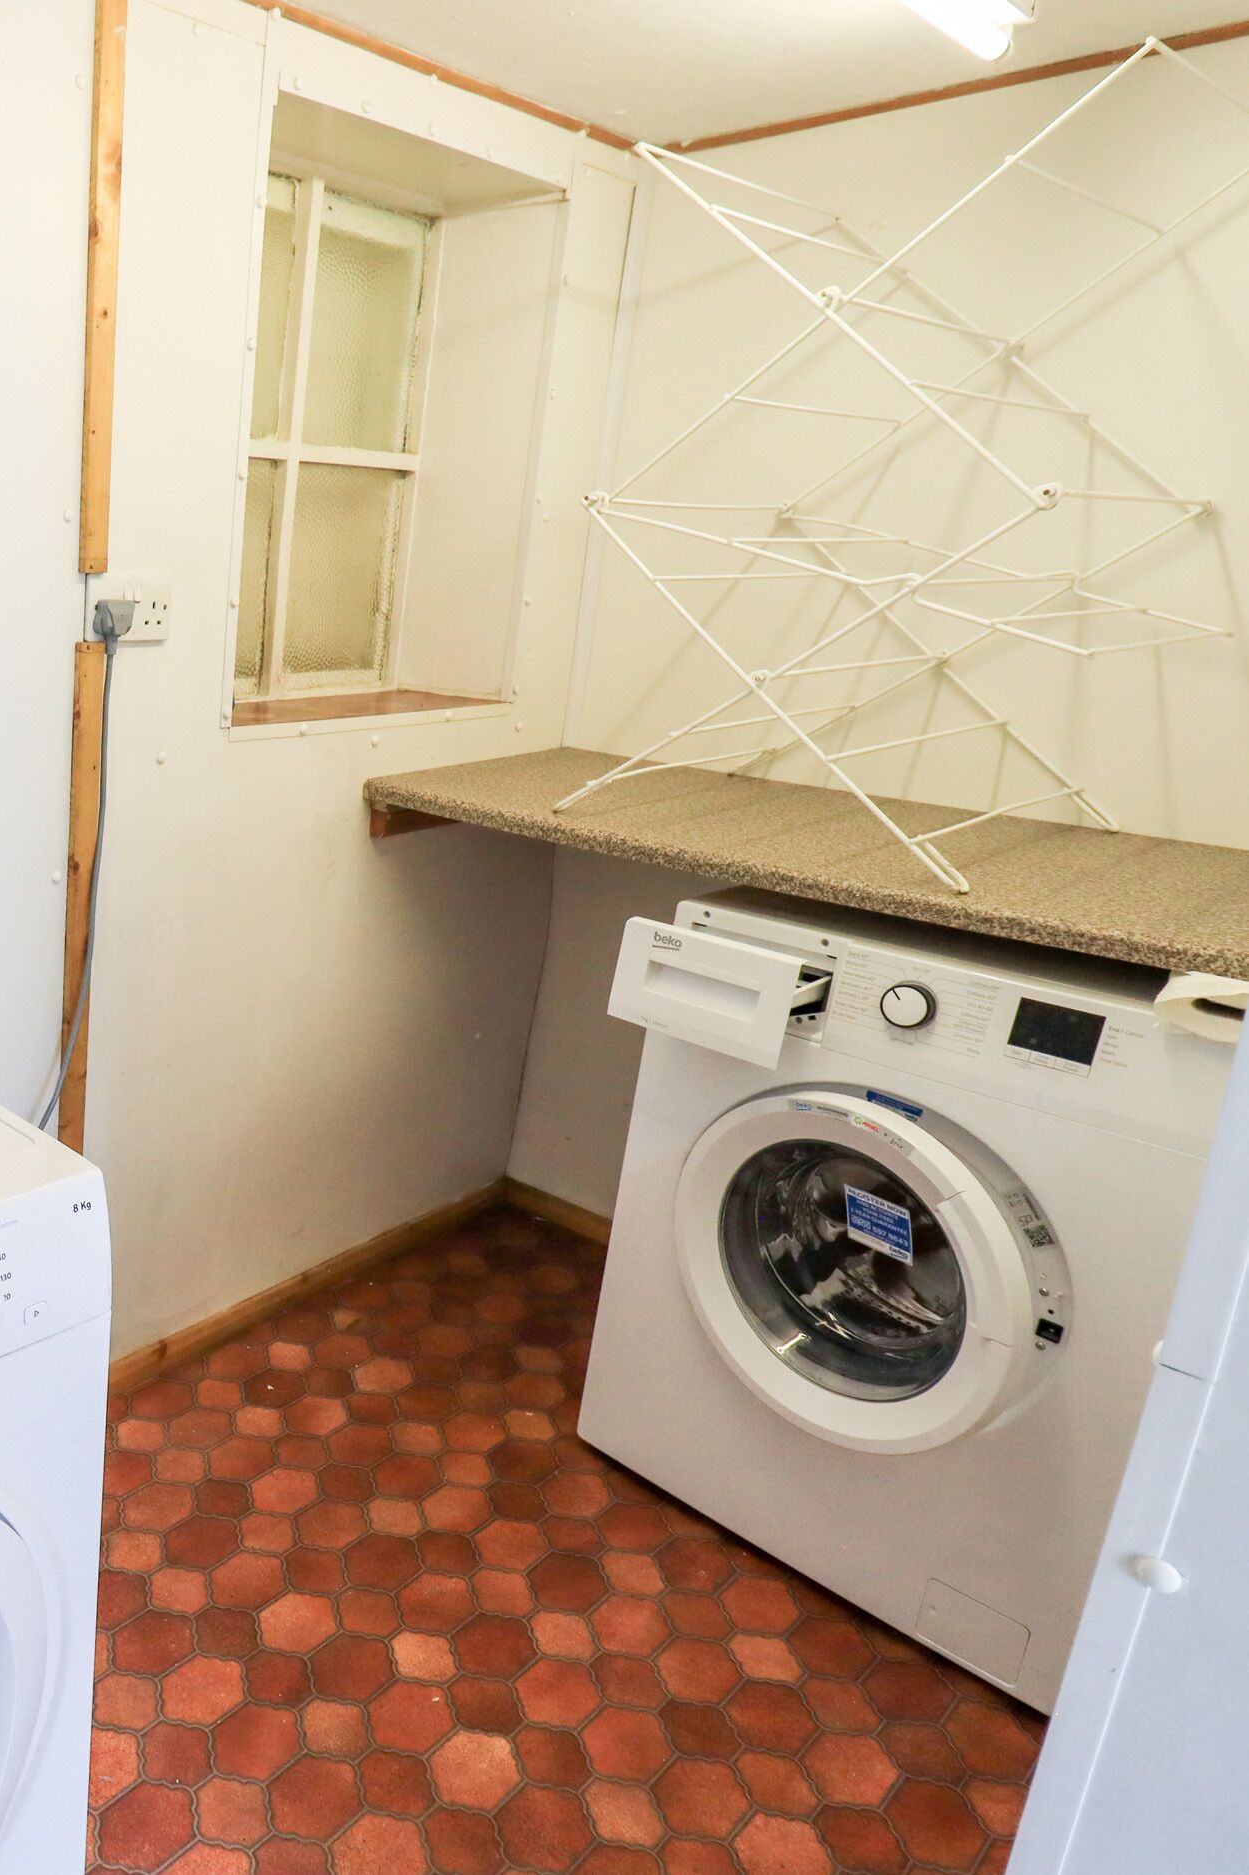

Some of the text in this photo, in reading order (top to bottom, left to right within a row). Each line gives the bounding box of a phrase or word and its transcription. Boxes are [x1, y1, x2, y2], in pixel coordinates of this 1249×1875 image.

[653, 931, 682, 948] beko
[73, 1200, 92, 1213] 8 Kg
[887, 1203, 907, 1217] NOW
